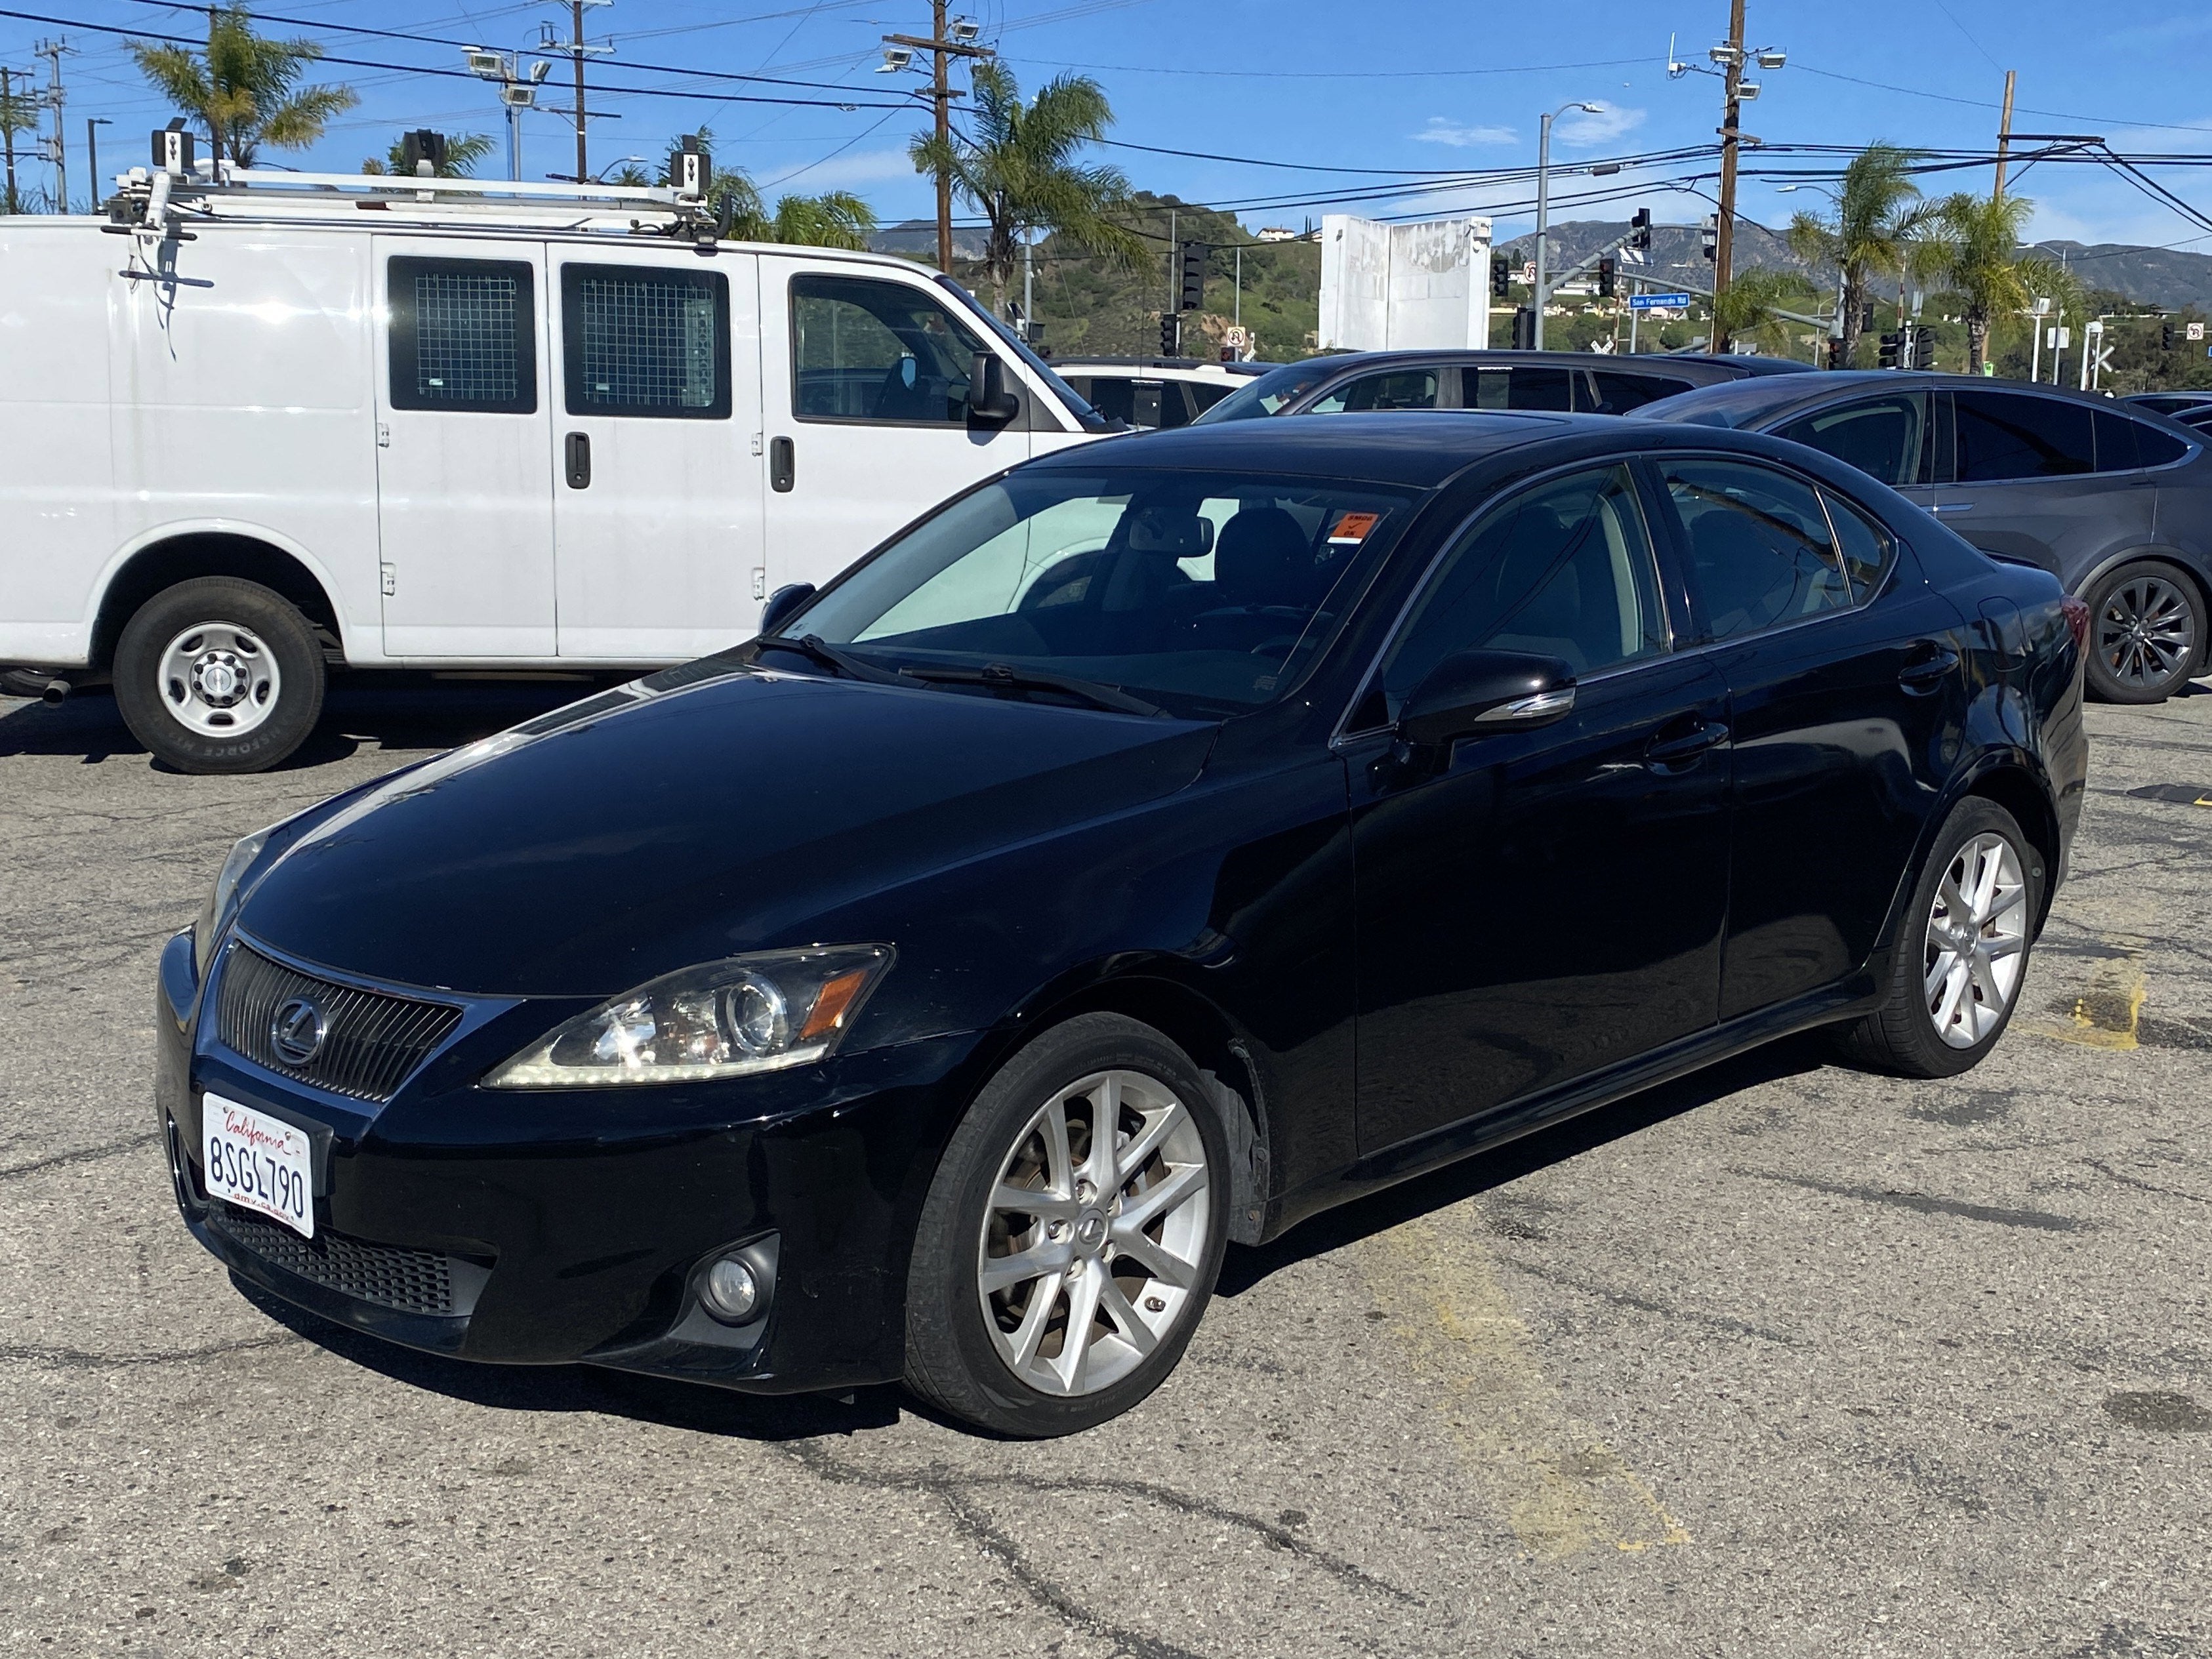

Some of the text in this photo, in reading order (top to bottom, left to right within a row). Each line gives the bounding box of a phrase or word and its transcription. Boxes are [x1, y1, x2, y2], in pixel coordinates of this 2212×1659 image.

[1633, 298, 1645, 306] San
[1646, 297, 1676, 306] Fernando
[226, 1111, 292, 1155] California
[211, 1136, 304, 1218] 8SGL790
